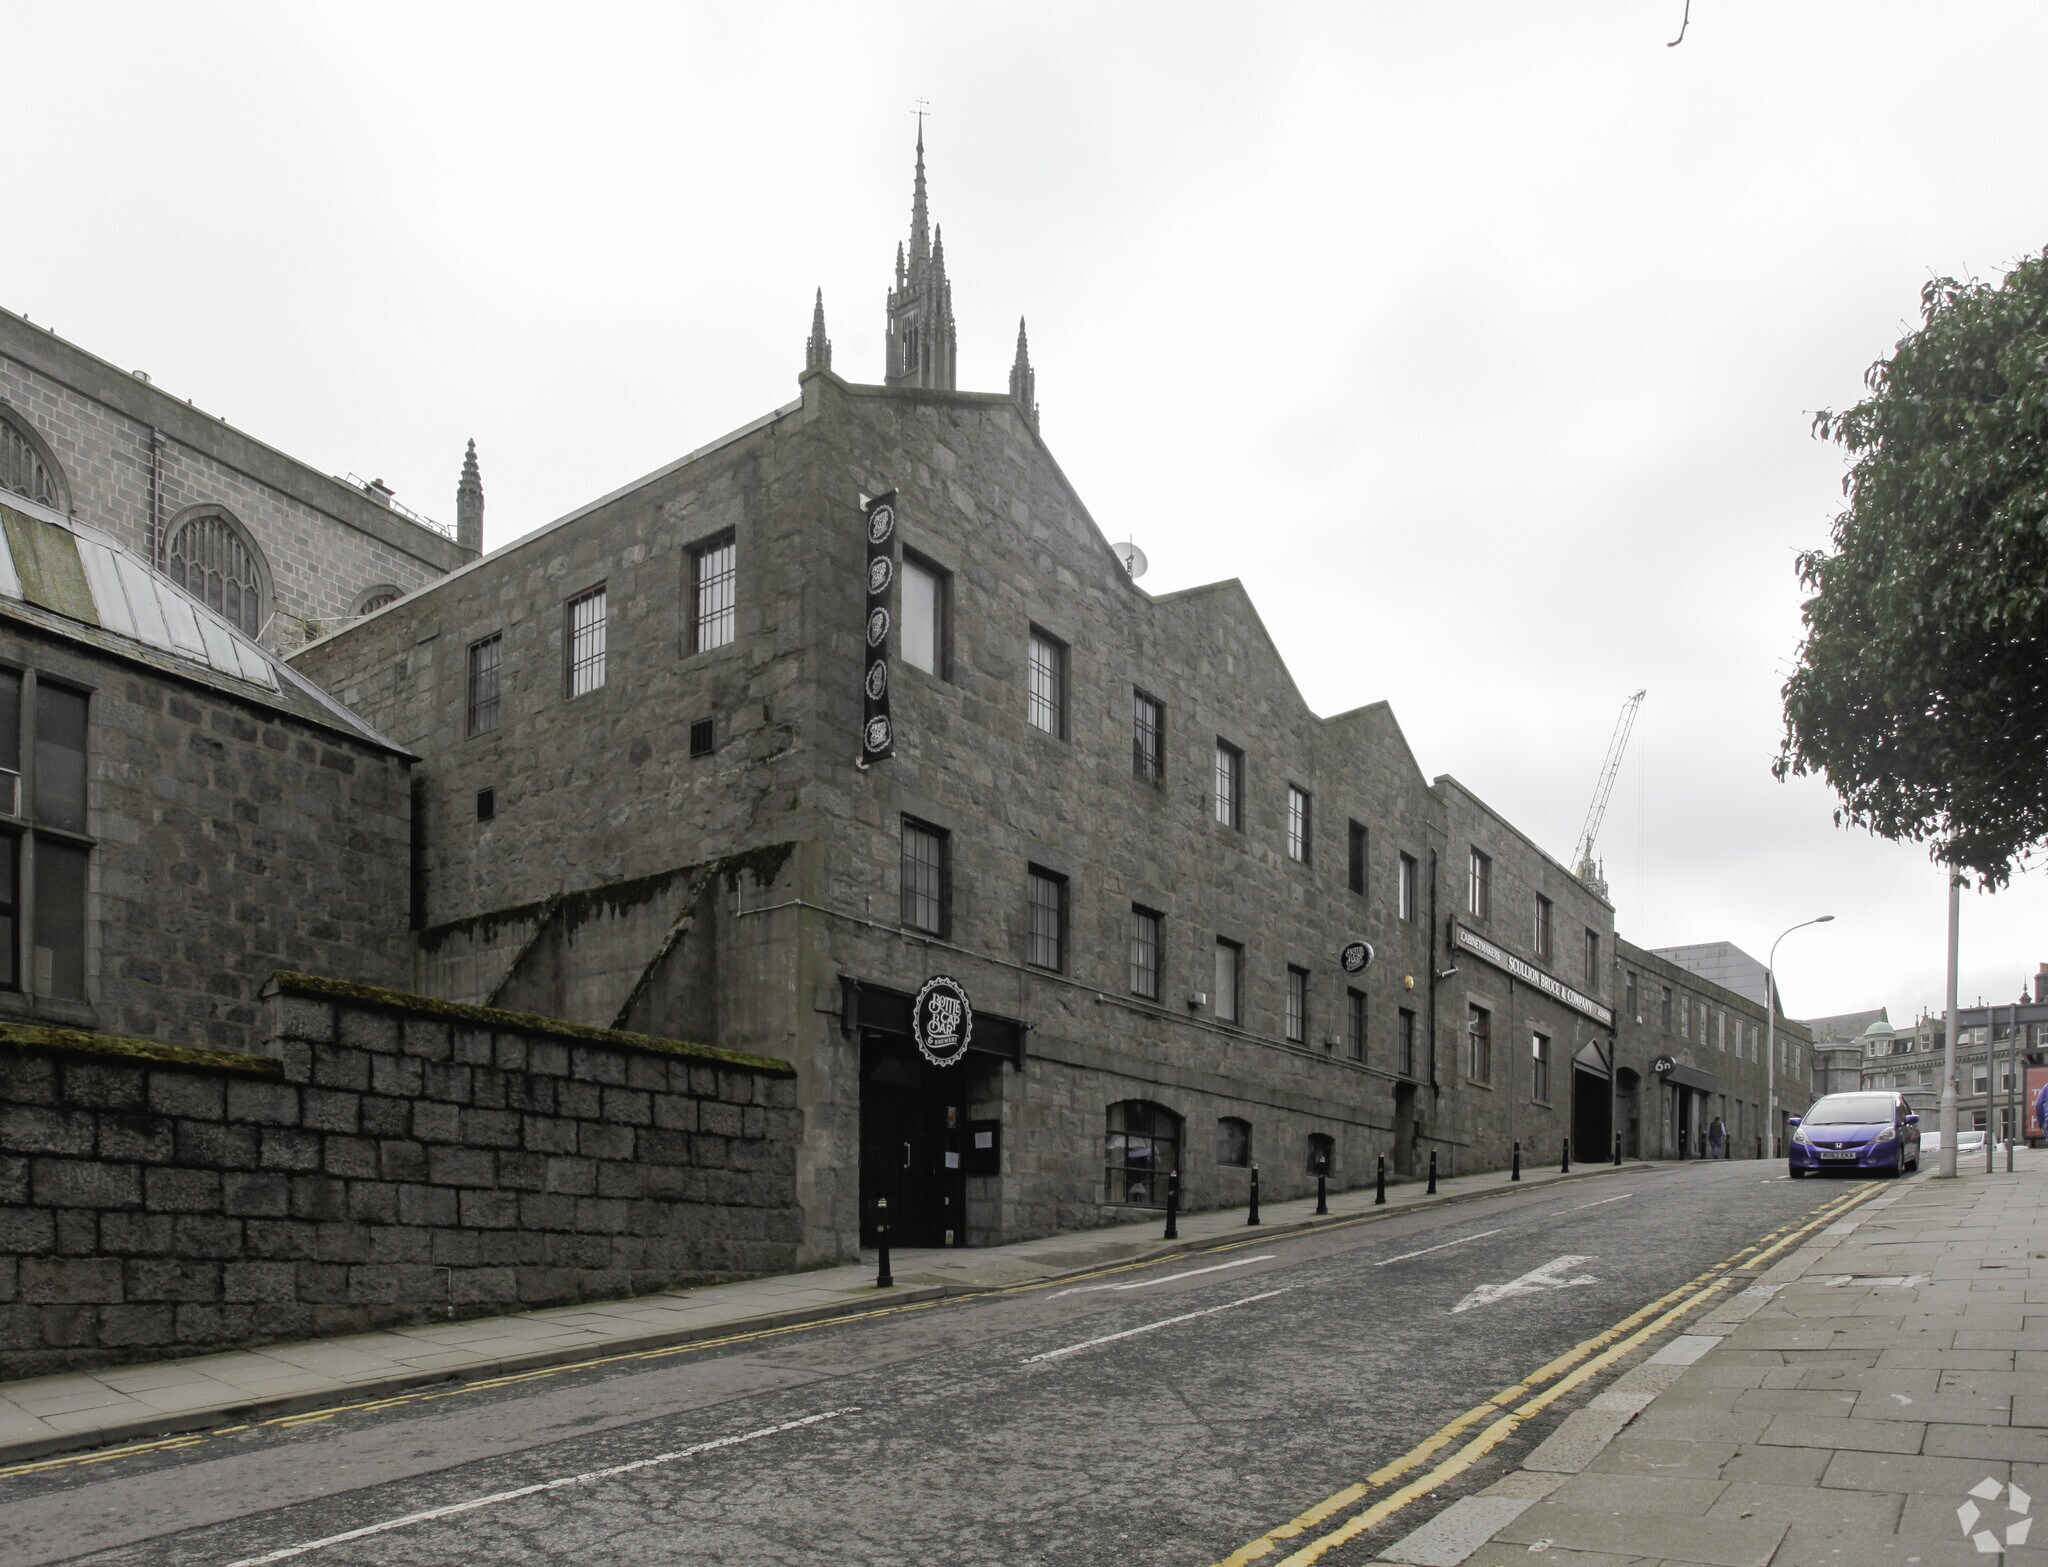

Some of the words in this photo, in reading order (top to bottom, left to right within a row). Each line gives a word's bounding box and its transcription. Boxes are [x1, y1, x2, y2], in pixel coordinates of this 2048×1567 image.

[1460, 931, 1500, 961] CABINETMAKERS
[1508, 956, 1540, 984] SCULLION
[1540, 974, 1560, 996] BRUCE
[1560, 985, 1567, 1000] &
[1567, 990, 1593, 1013] COMPANY
[928, 993, 961, 1016] BOTTLE
[928, 1014, 953, 1035] BAR
[941, 1011, 960, 1031] CAP
[934, 1037, 958, 1046] BREWERY
